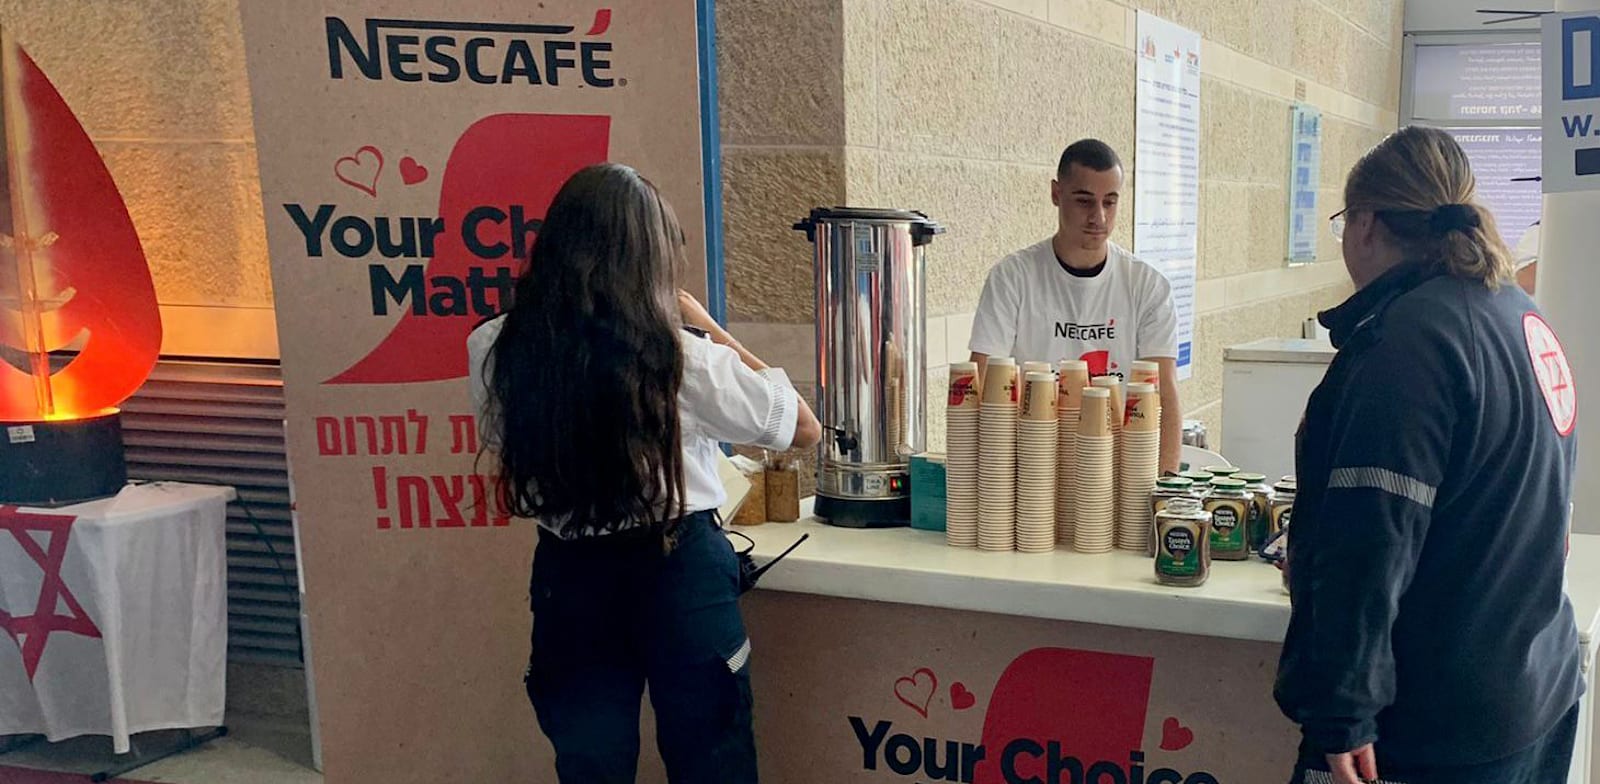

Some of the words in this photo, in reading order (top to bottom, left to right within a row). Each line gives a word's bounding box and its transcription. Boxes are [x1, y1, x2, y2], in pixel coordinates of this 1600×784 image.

[325, 9, 614, 87] NESCAFÉ
[283, 203, 445, 258] Your
[315, 408, 429, 456] לתרום
[848, 716, 985, 783] Your
